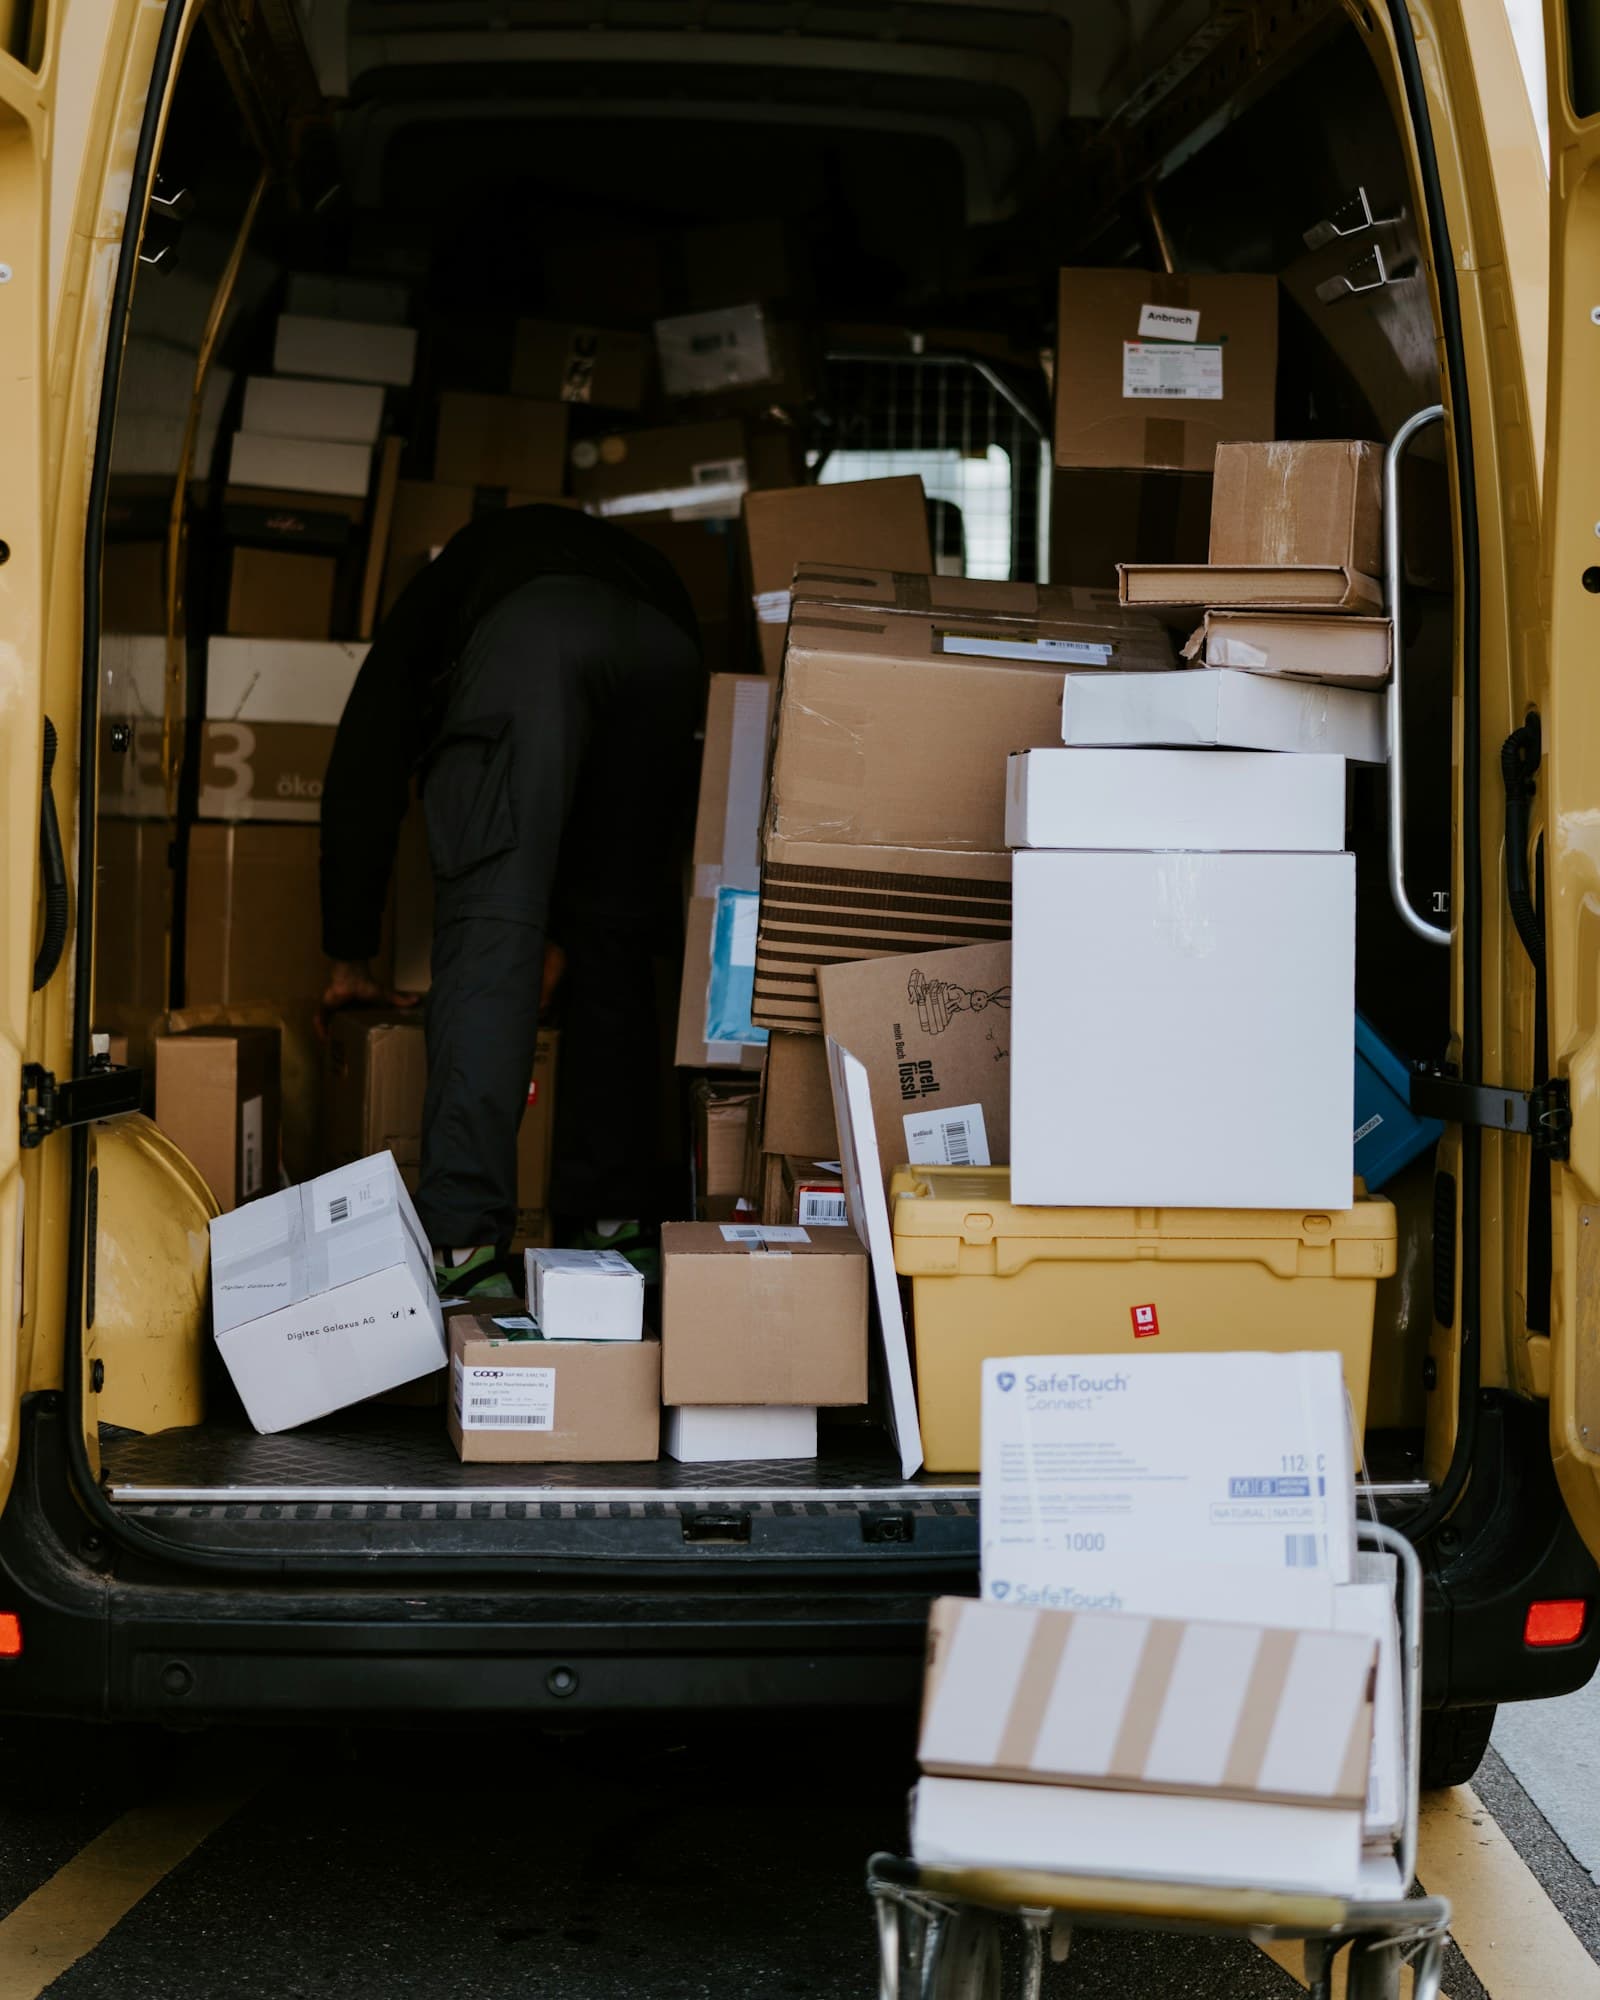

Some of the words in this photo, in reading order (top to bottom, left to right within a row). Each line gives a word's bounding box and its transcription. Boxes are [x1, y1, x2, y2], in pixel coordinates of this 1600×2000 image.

[1147, 311, 1193, 325] Anbruch
[893, 1023, 902, 1041] mein
[895, 1041, 906, 1060] Buch
[286, 1327, 321, 1341] Digitec
[322, 1320, 360, 1334] Galaxus
[362, 1316, 376, 1326] AG
[472, 1370, 504, 1380] coop
[1024, 1373, 1128, 1393] SafeTouch
[1064, 1532, 1107, 1552] 1000
